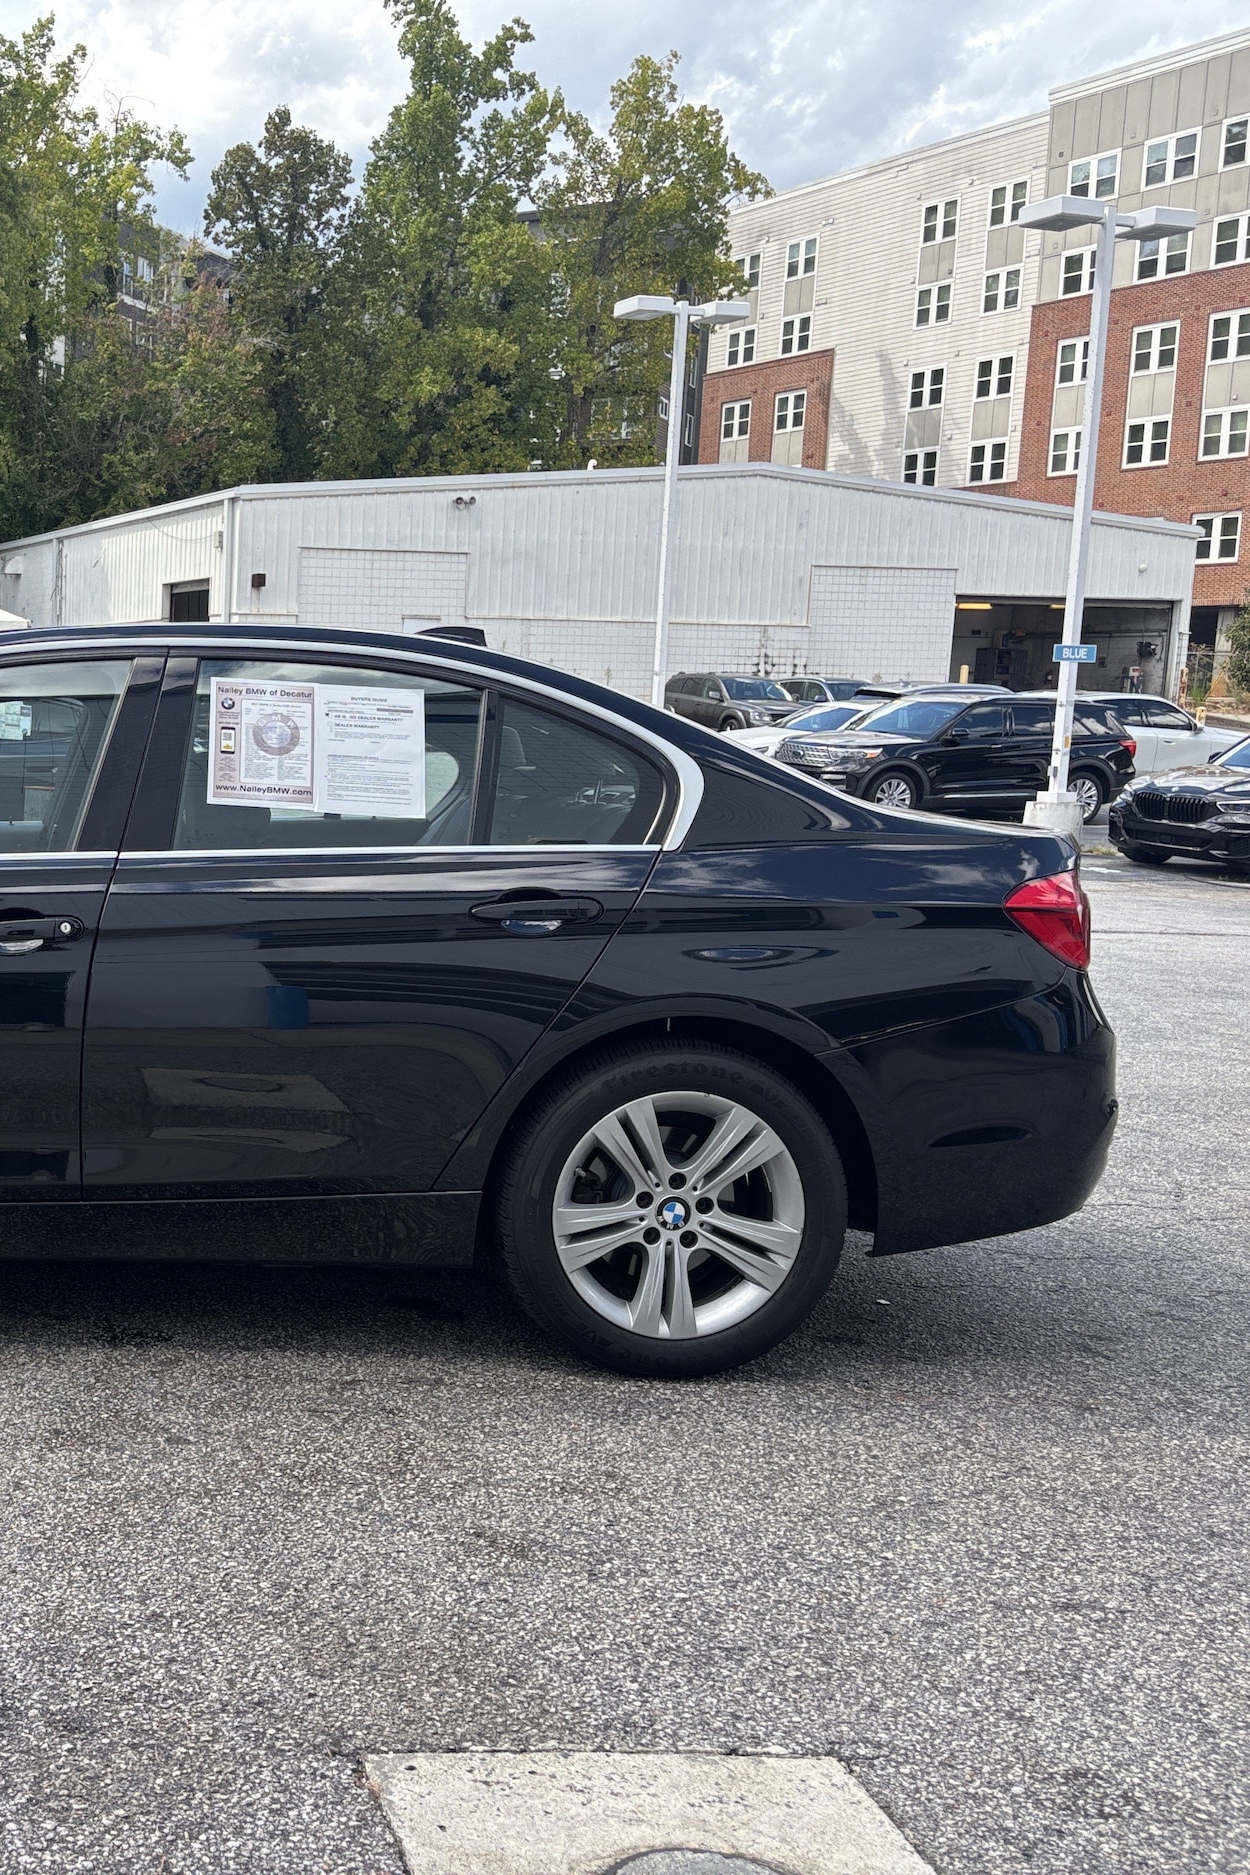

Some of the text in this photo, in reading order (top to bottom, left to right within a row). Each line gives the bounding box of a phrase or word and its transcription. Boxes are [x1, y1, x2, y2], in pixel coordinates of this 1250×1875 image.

[1062, 647, 1088, 659] BLUE
[217, 686, 243, 696] Nalley
[245, 687, 267, 696] BMW
[280, 690, 313, 698] Decatur
[215, 784, 313, 797] www.NalleyBMW.com
